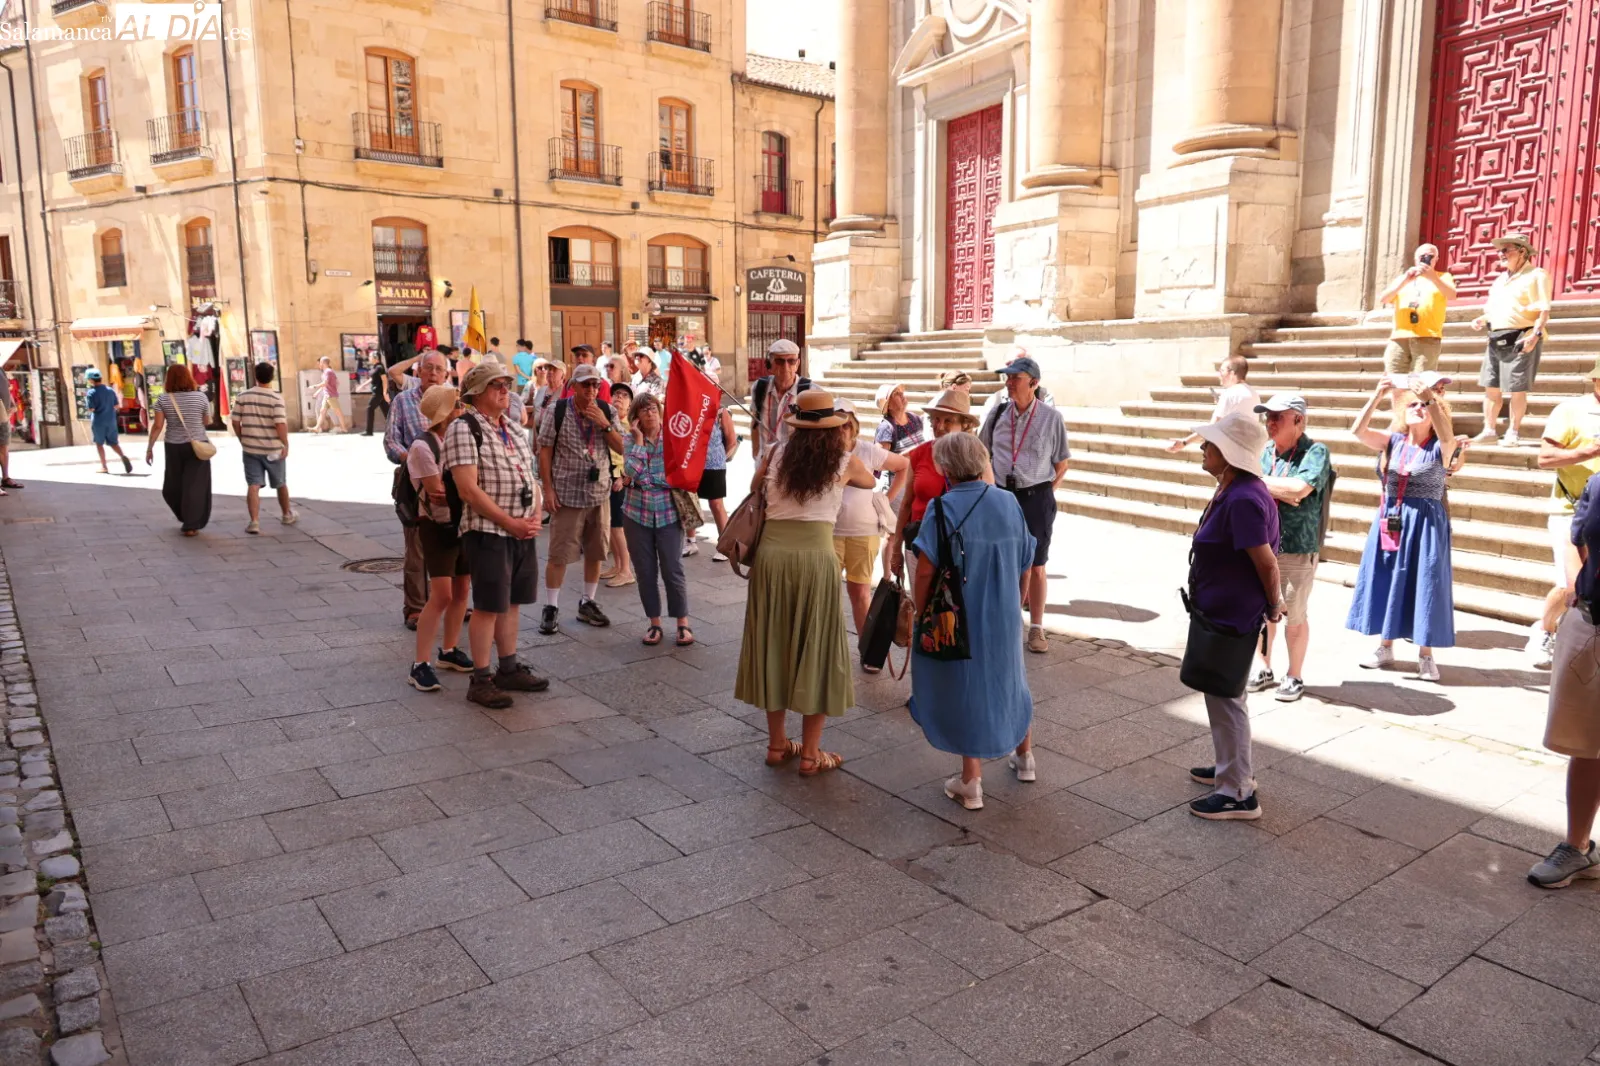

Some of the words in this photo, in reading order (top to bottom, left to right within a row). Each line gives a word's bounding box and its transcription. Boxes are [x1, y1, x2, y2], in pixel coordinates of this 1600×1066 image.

[750, 268, 803, 282] CAFETERIA
[378, 286, 428, 299] MARMA
[750, 290, 764, 301] Las
[765, 291, 803, 303] Campanas
[681, 393, 711, 469] travelmarvel
